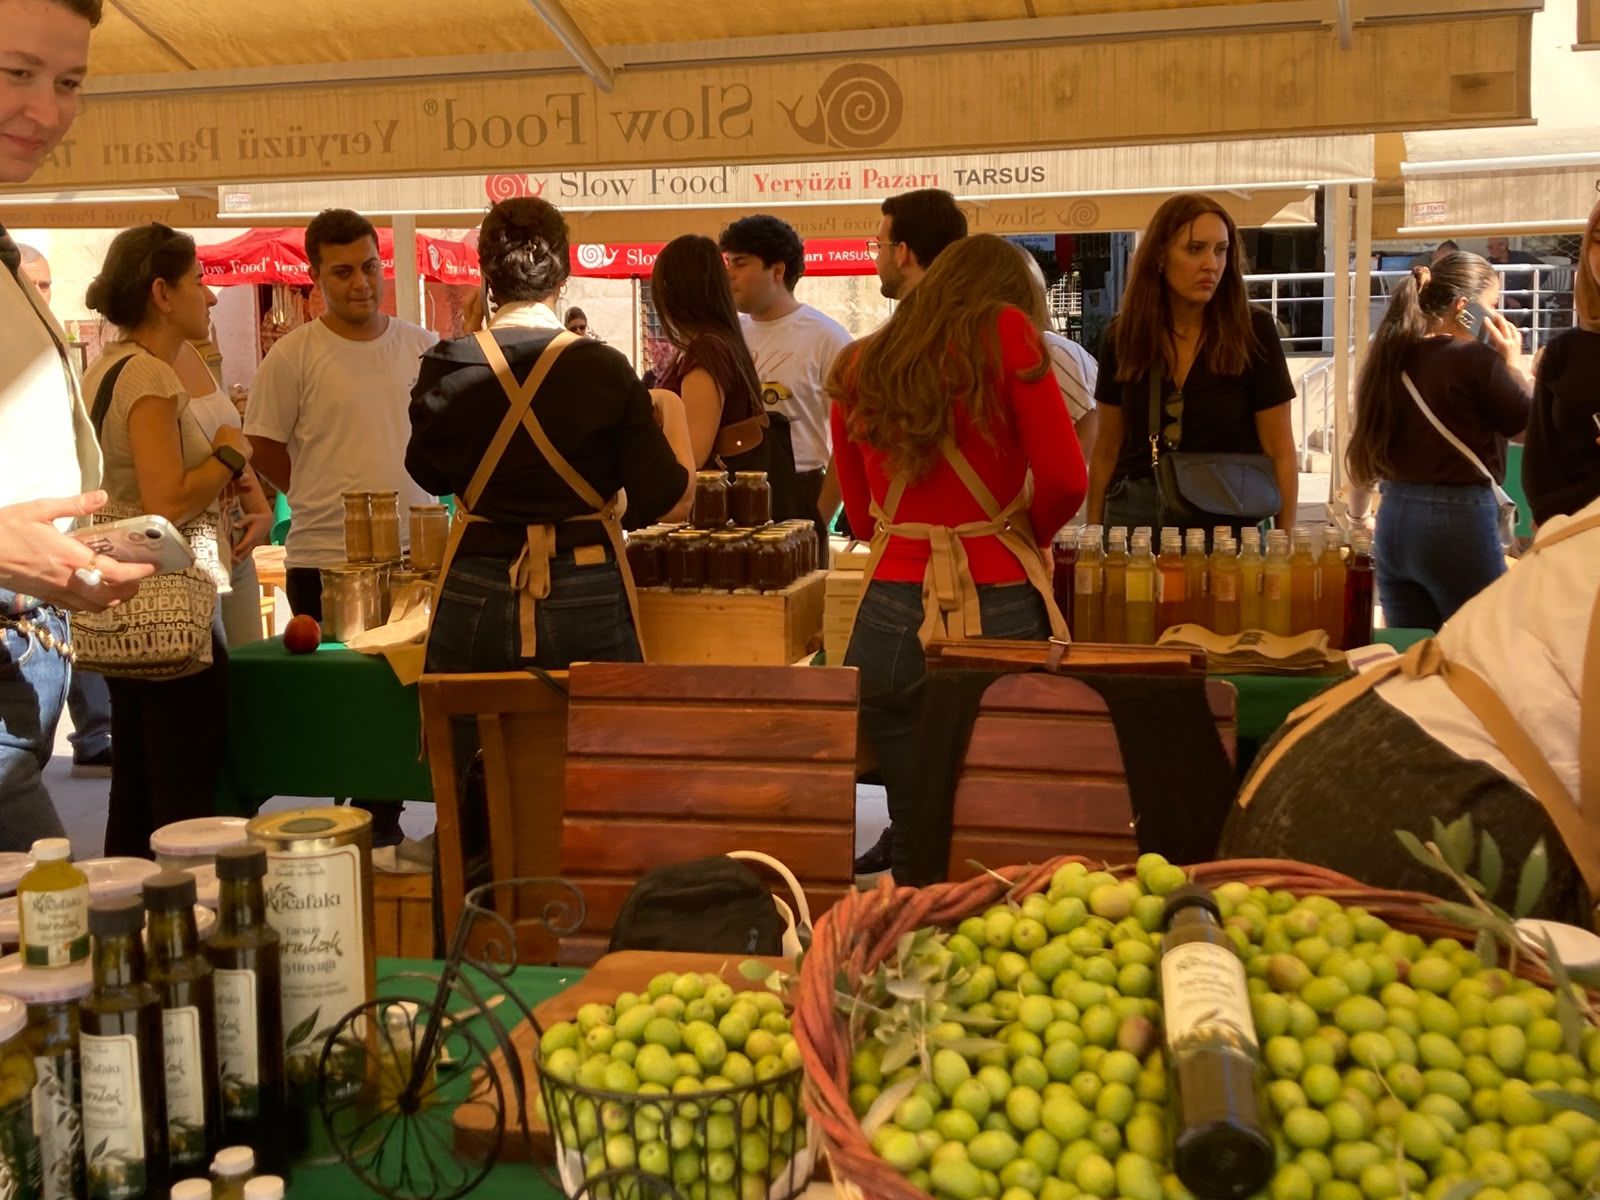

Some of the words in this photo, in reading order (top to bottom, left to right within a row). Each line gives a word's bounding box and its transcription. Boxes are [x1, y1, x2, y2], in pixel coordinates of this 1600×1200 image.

[560, 171, 636, 198] Slow
[754, 171, 852, 198] Yeryüzü
[862, 168, 939, 190] Pazarı
[953, 165, 1046, 187] TARSUS
[199, 260, 226, 275] low
[129, 595, 190, 614] DUBAI
